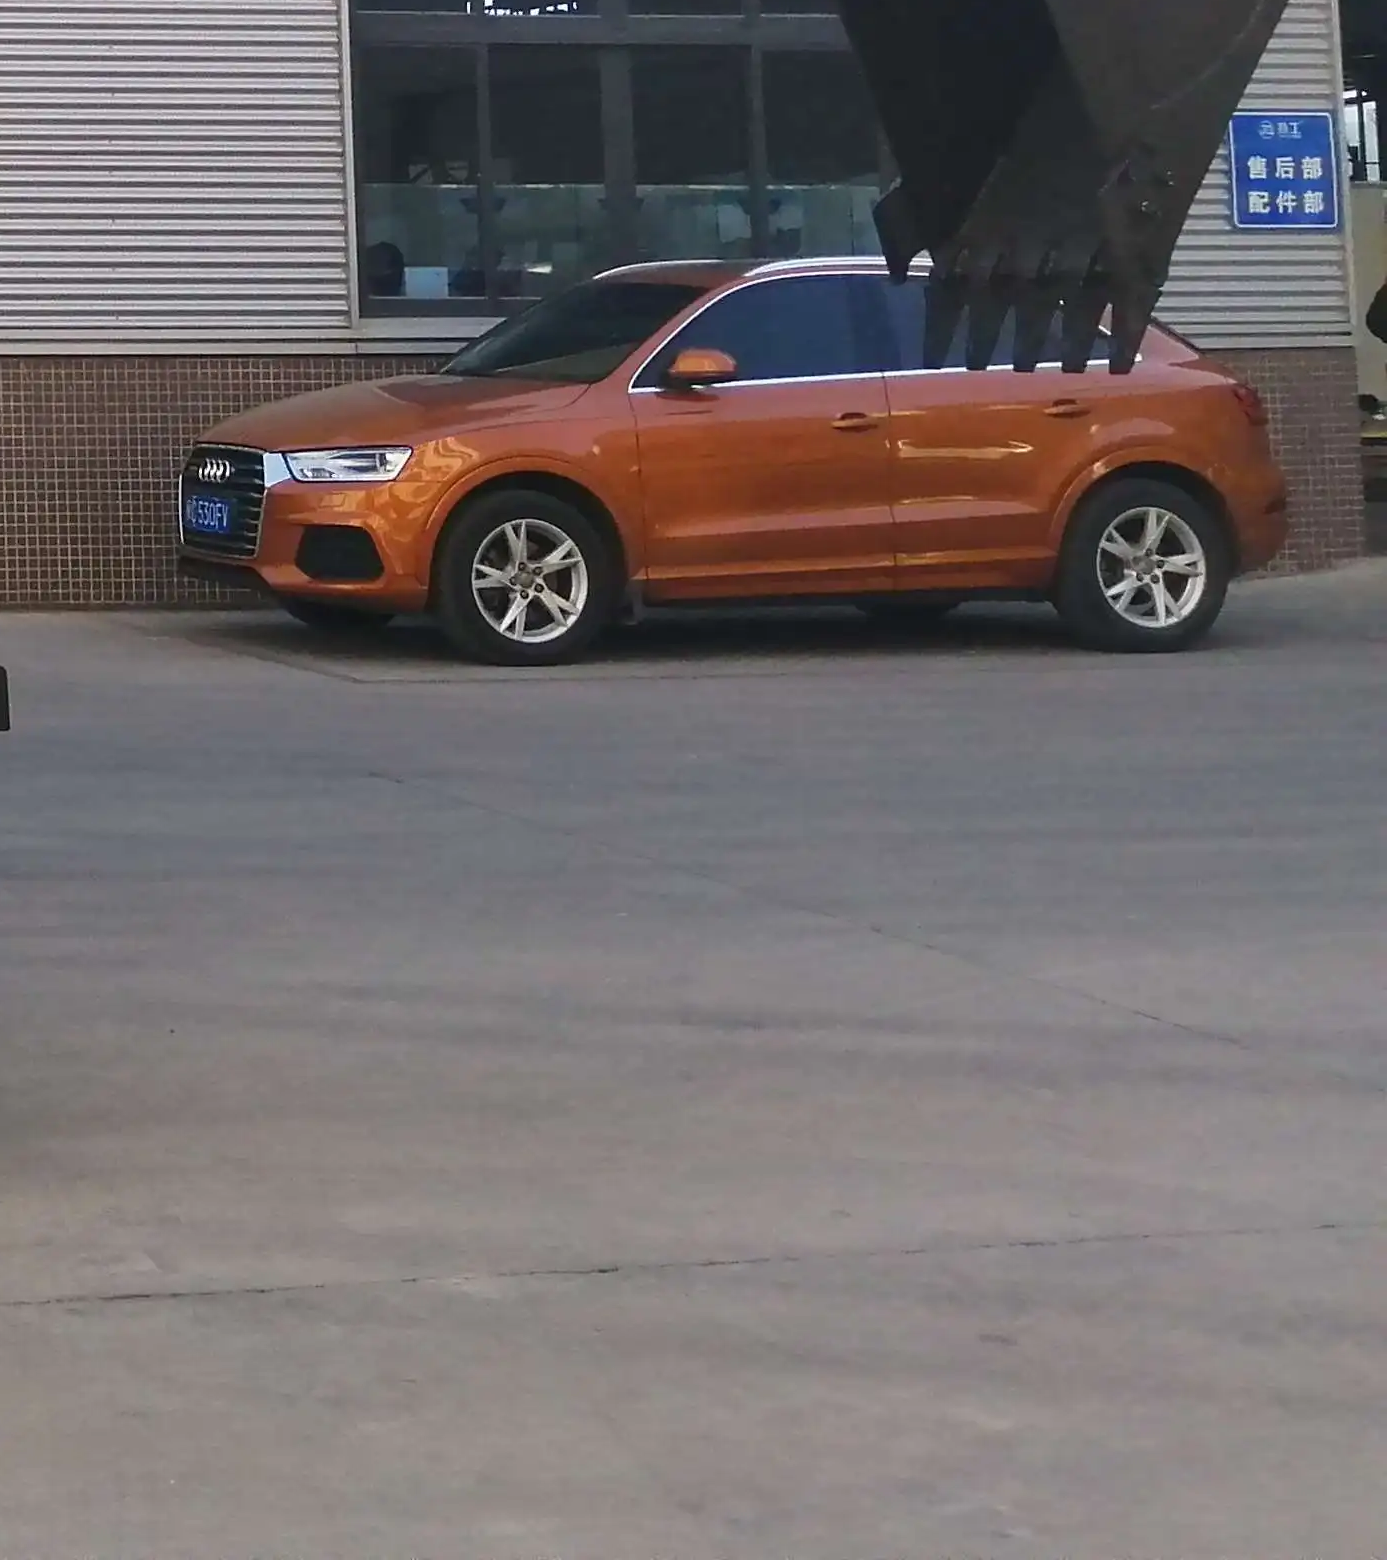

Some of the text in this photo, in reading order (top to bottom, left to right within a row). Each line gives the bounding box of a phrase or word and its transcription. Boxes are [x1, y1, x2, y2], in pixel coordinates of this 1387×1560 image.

[1247, 155, 1323, 180] 售后部
[1247, 190, 1325, 214] 配件部
